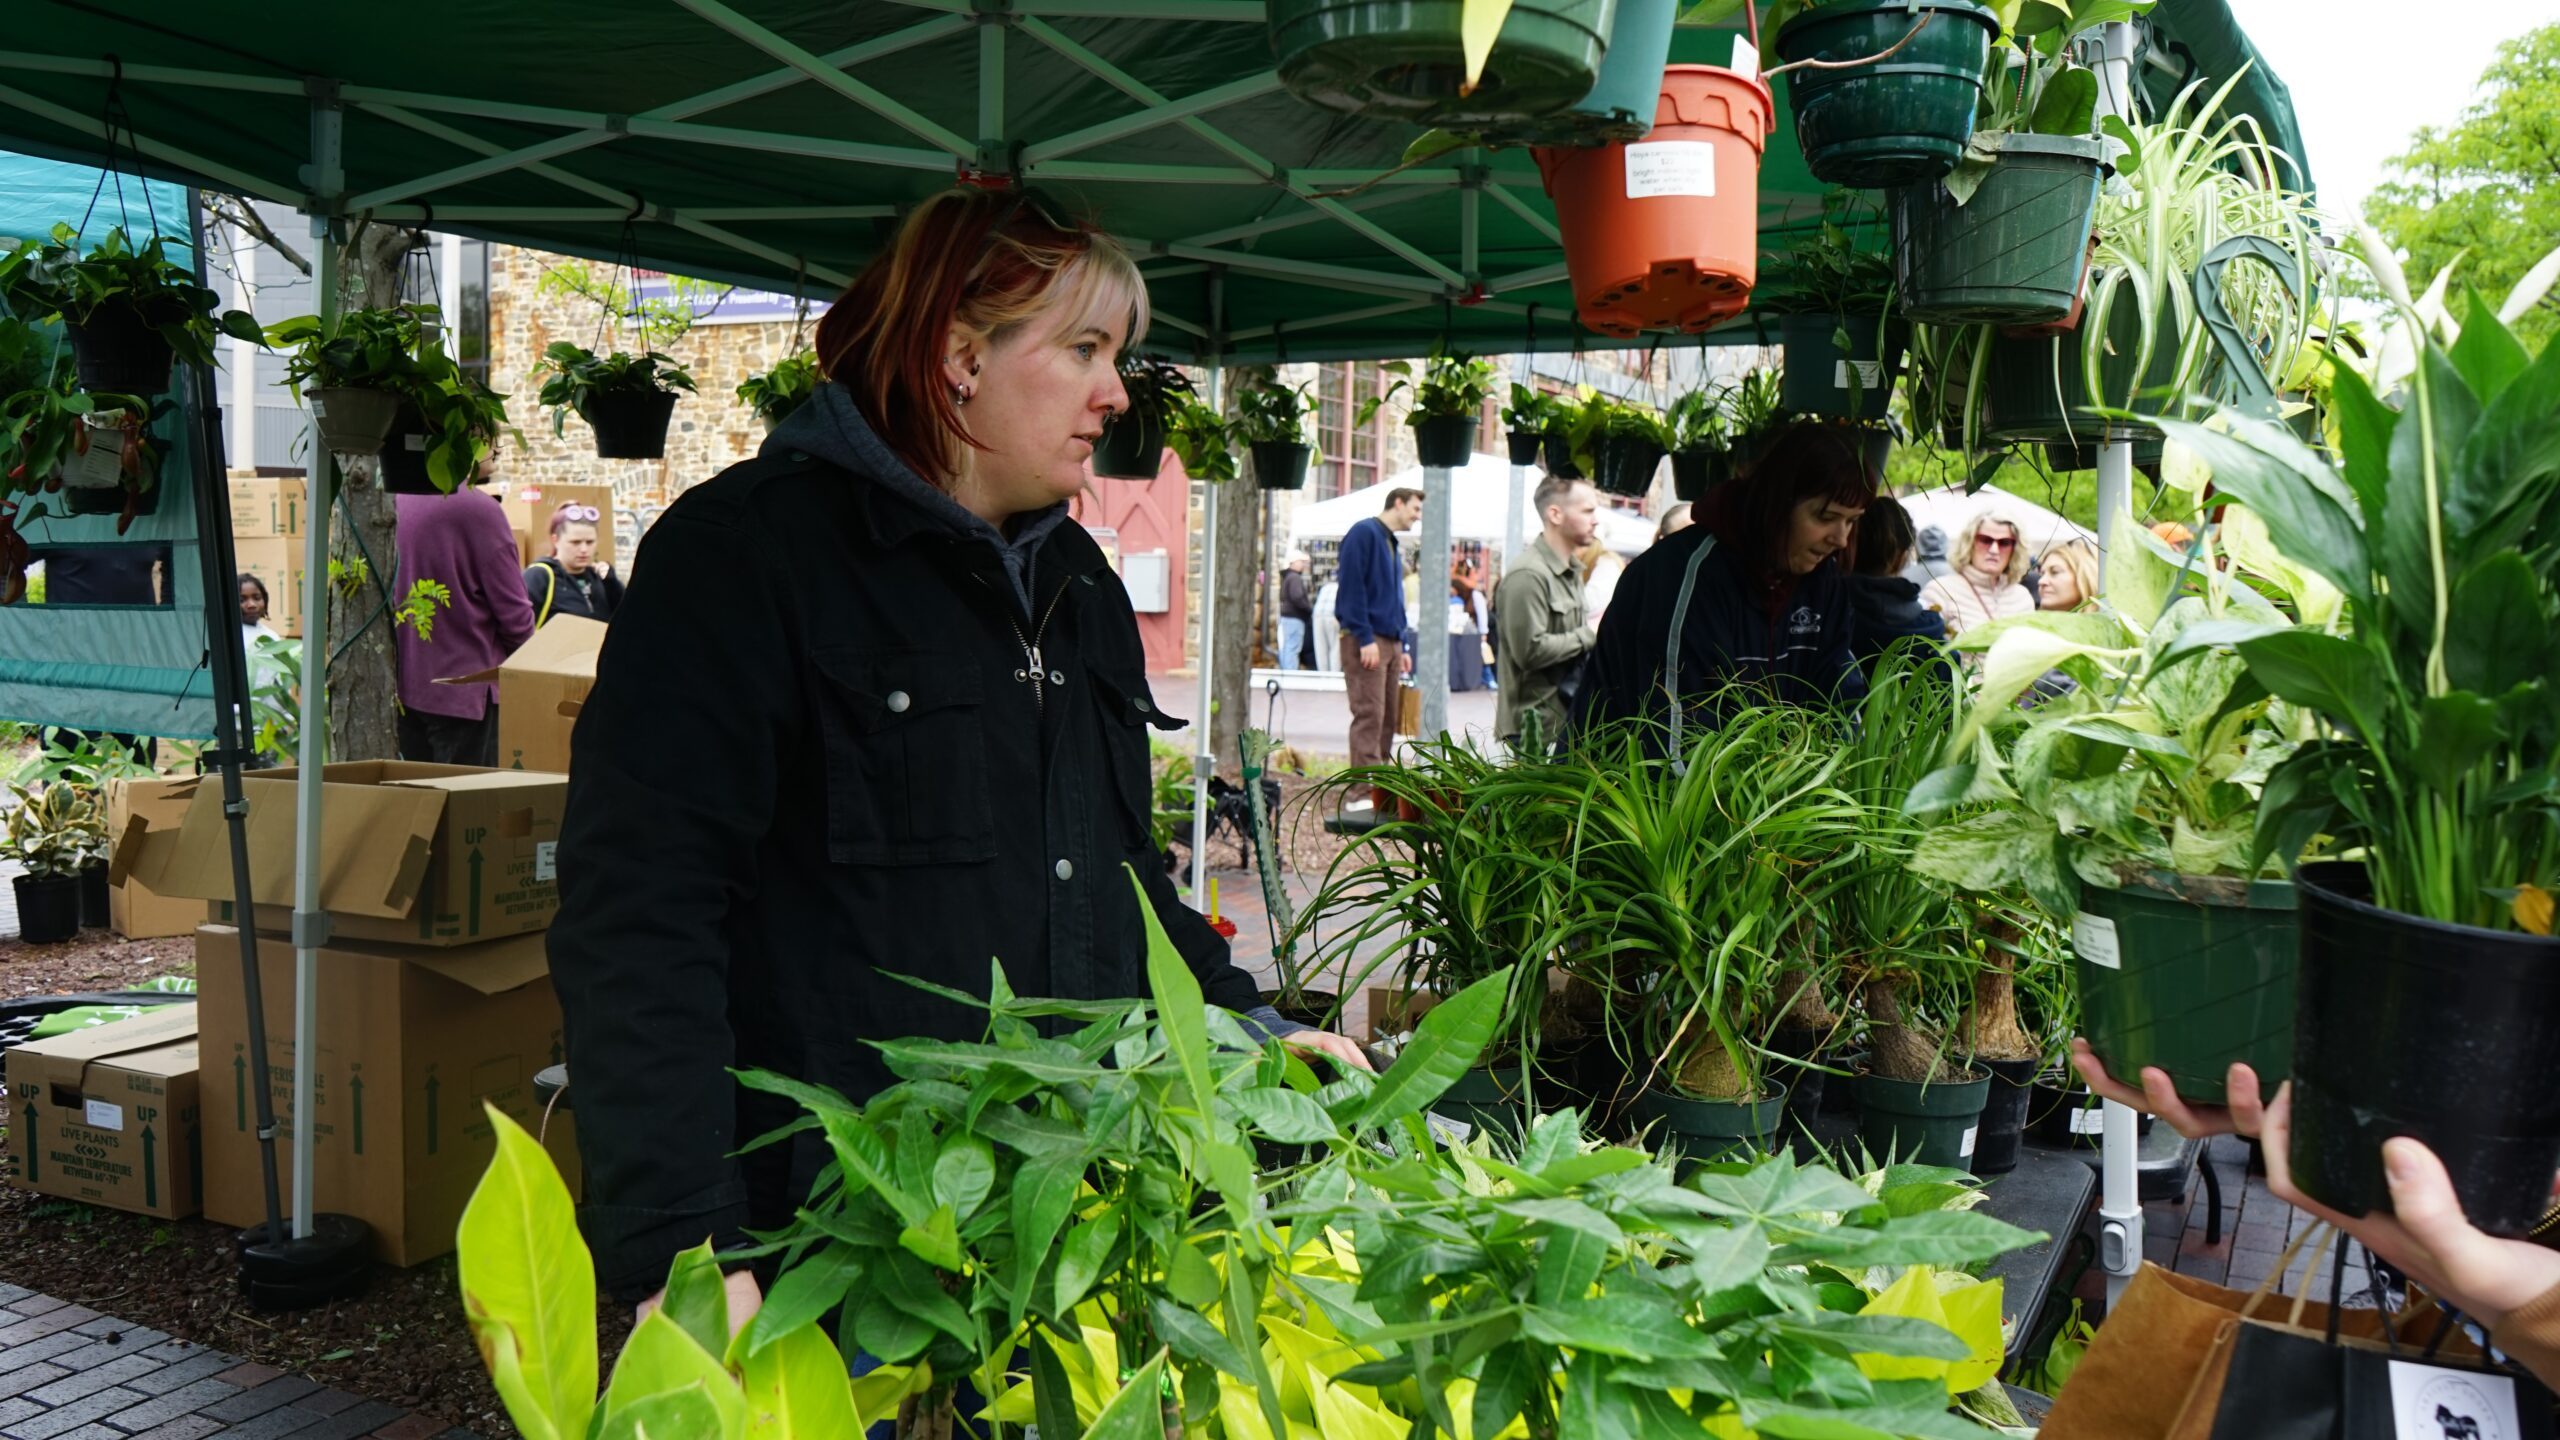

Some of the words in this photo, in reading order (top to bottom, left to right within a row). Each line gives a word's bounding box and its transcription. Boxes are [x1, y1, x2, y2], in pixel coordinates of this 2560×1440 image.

[464, 827, 487, 845] UP
[507, 862, 528, 876] LIVE
[19, 1082, 40, 1099] UP
[137, 1105, 158, 1123] UP
[61, 1127, 82, 1141] LIVE
[82, 1131, 120, 1148] PLANTS
[50, 1150, 84, 1166] MAINTAIN
[86, 1155, 133, 1177] TEMPERATURE
[63, 1166, 94, 1180] BETWEEN
